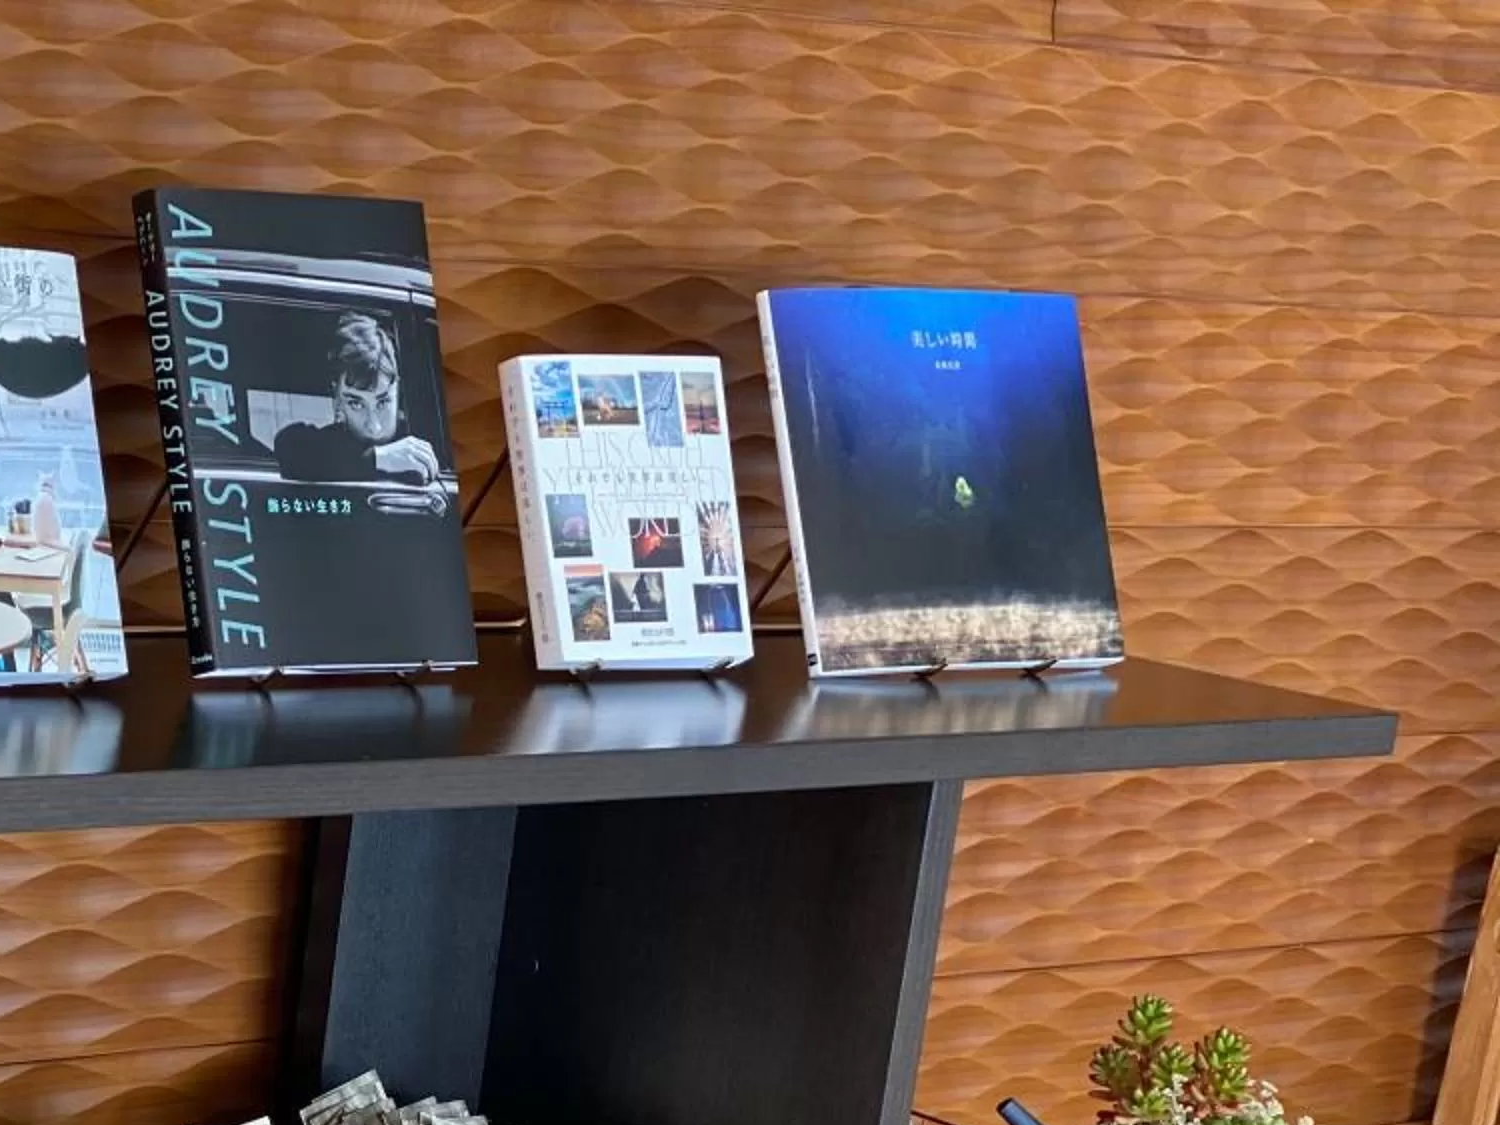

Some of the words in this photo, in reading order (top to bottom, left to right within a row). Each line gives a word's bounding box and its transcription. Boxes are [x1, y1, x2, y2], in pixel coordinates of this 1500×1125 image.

[145, 289, 179, 408] AUDREY
[162, 424, 193, 514] STYLE
[167, 202, 241, 446] AUDREY
[202, 477, 269, 651] STYLE
